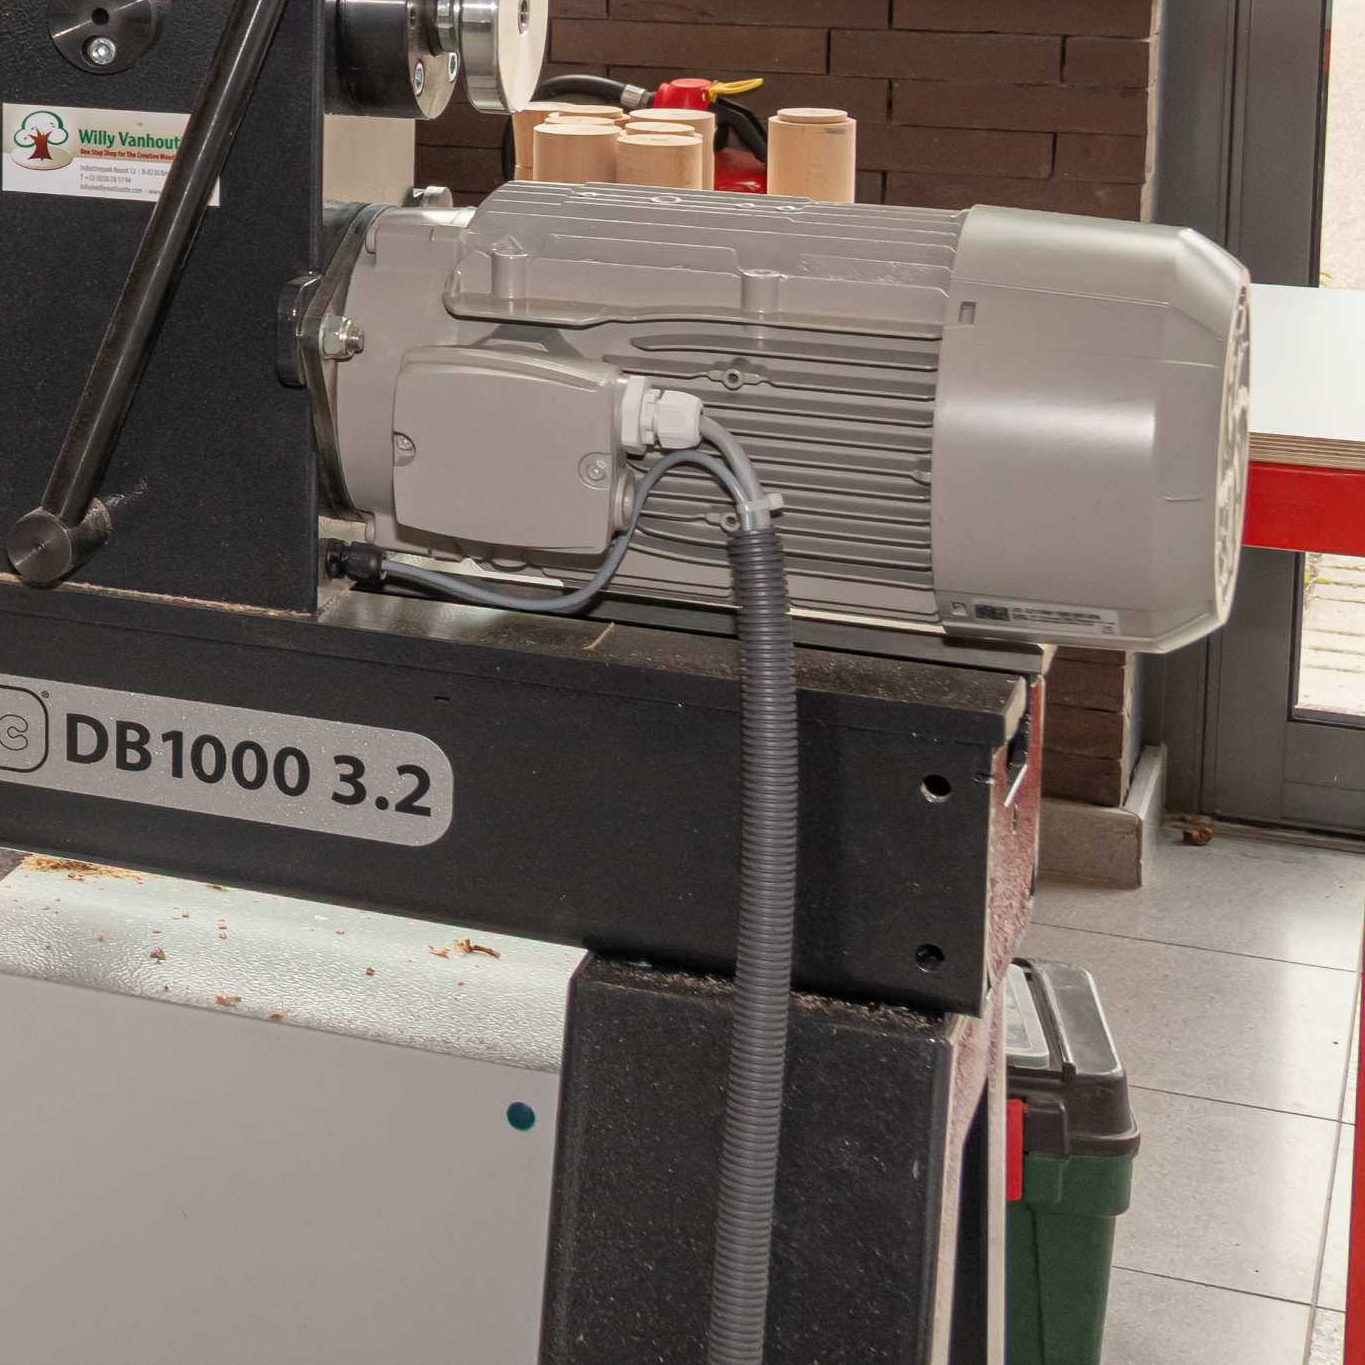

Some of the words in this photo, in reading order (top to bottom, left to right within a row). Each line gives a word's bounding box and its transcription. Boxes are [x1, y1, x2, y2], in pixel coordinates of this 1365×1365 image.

[78, 128, 116, 149] Willy
[118, 131, 181, 150] Vanhout
[66, 713, 311, 797] DB1000
[331, 754, 433, 817] 3.2
